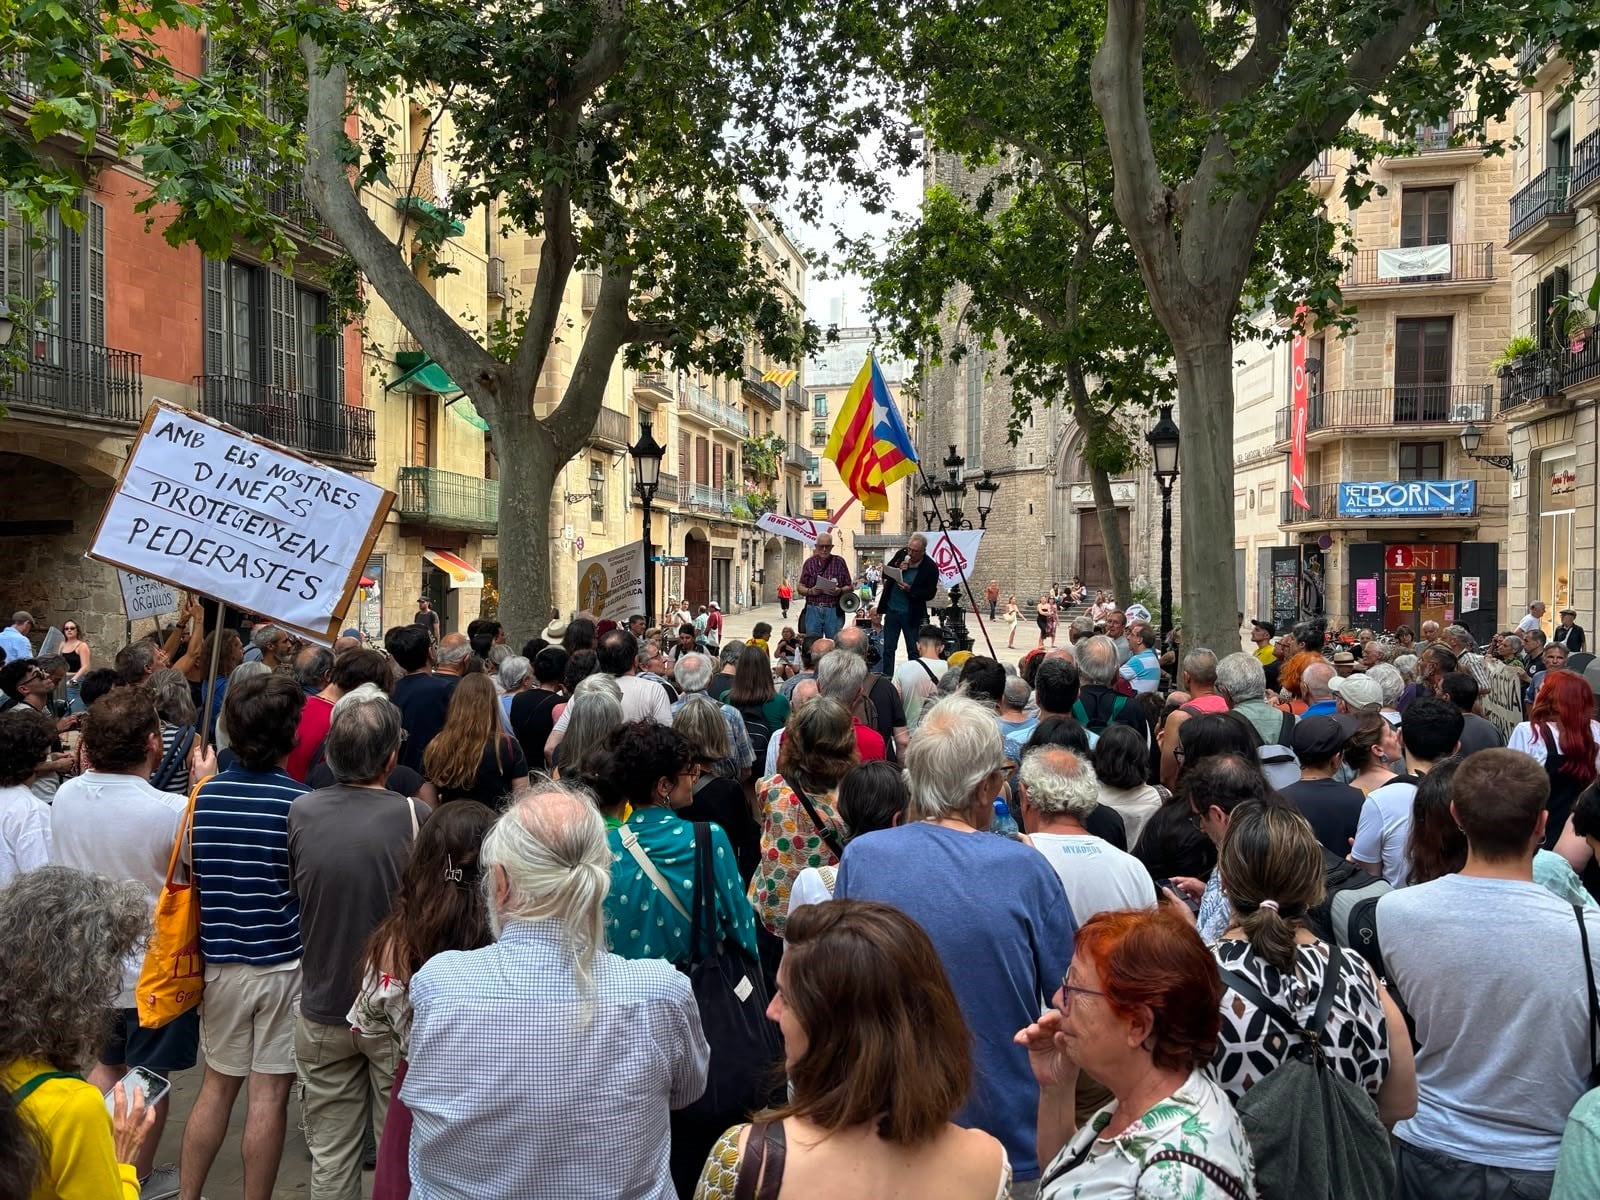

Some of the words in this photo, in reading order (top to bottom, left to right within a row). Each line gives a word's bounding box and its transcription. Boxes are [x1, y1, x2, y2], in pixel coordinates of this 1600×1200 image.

[155, 422, 205, 448] AMB
[224, 445, 259, 469] ELS
[266, 464, 360, 510] NOSTRES
[194, 462, 312, 518] DINERS
[1346, 485, 1366, 496] FET
[1368, 483, 1455, 507] BORN
[151, 481, 329, 564] PROTEGEIXEN
[1346, 497, 1367, 507] AL
[128, 518, 323, 600] PEDERASTES
